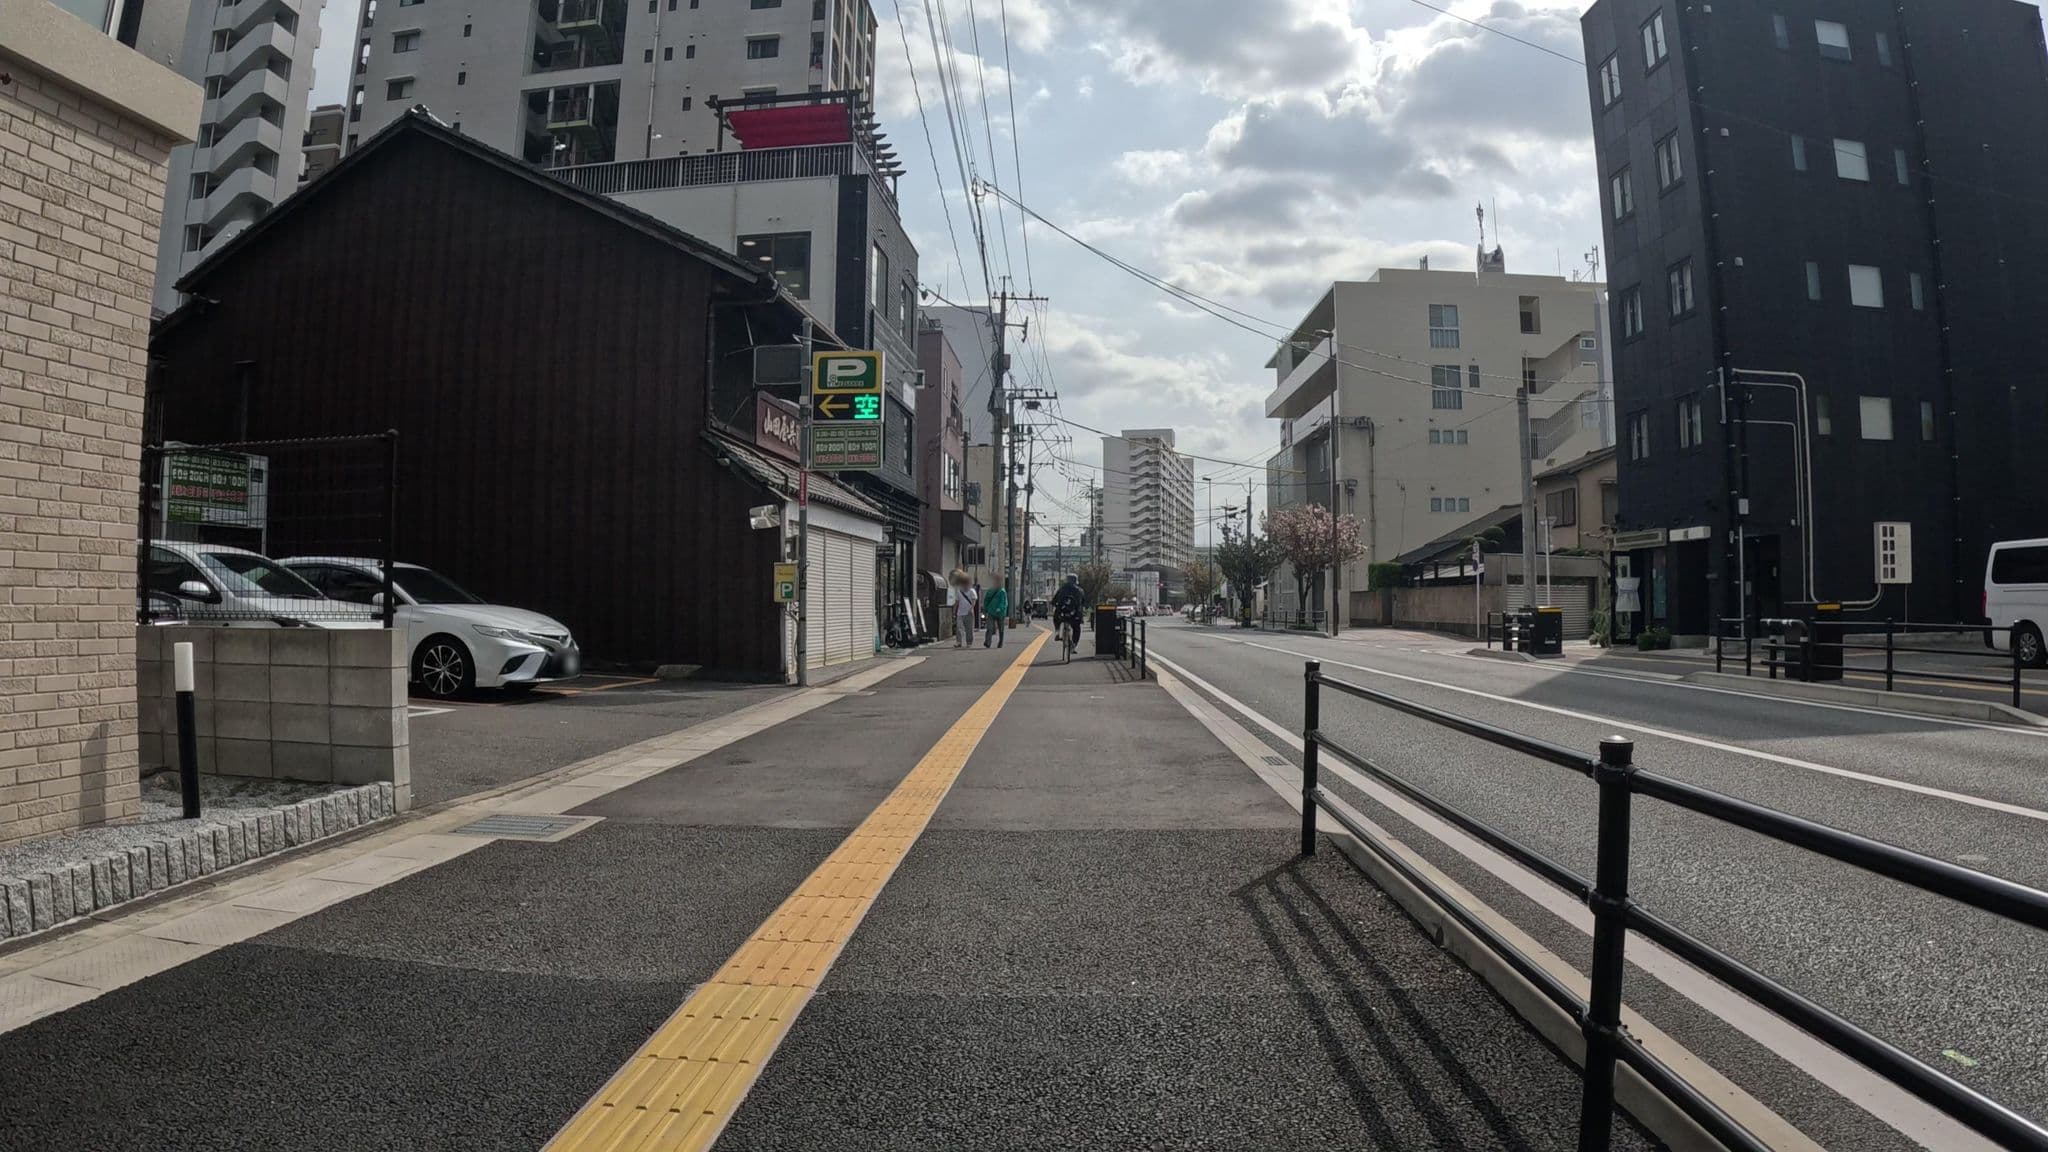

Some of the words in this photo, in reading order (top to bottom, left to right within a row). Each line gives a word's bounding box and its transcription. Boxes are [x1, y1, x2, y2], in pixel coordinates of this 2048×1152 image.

[827, 359, 867, 387] P
[854, 394, 879, 419] 空
[782, 583, 793, 597] P
